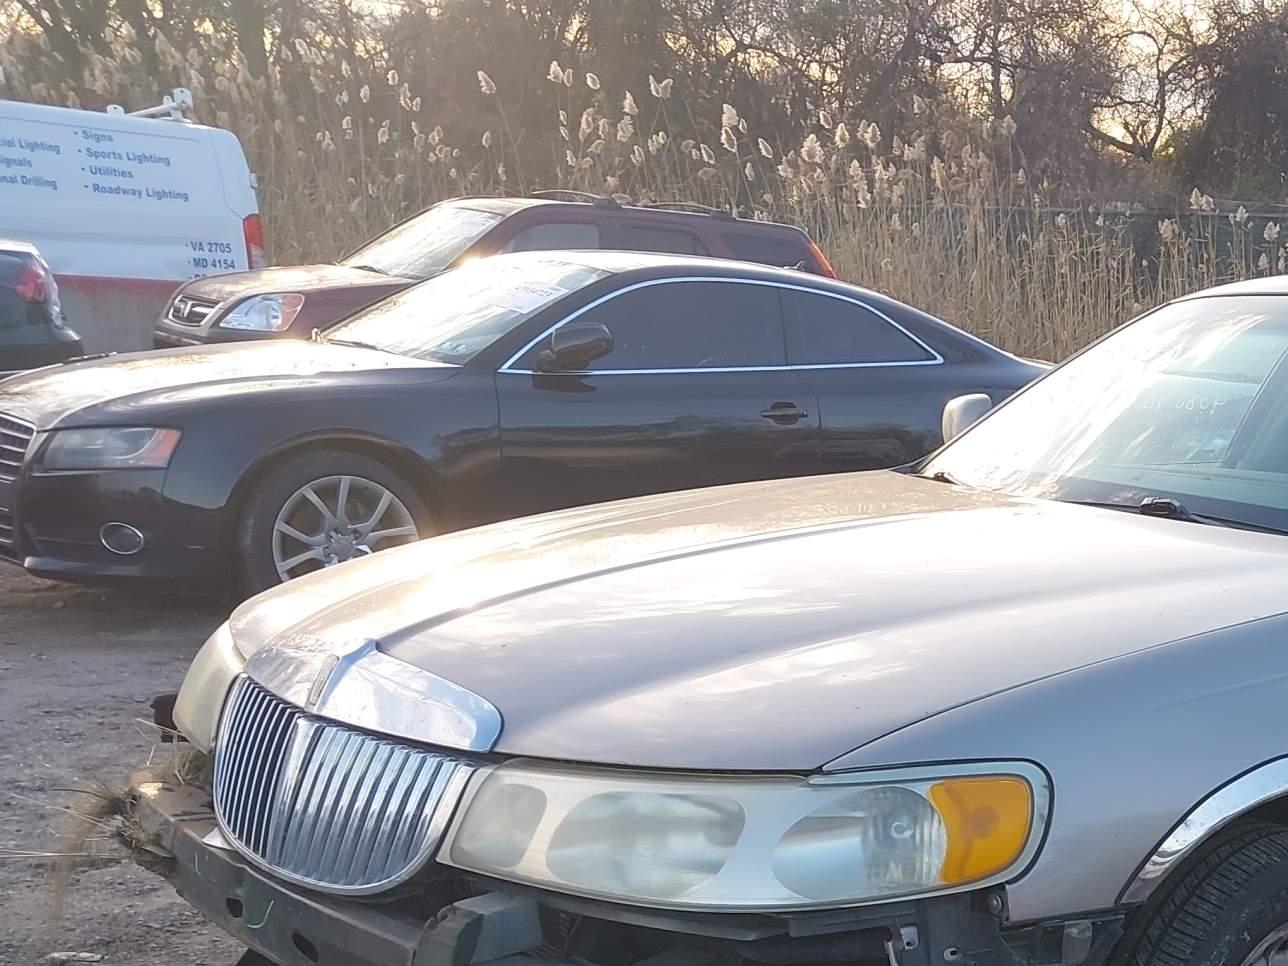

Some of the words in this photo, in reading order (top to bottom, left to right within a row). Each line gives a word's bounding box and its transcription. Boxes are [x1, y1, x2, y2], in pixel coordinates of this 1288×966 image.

[82, 130, 114, 143] Signs
[18, 138, 61, 155] Lighting
[86, 147, 123, 160] Sports
[126, 151, 171, 167] Lighting
[89, 165, 134, 178] Utilities
[21, 175, 58, 190] Drilling
[92, 183, 142, 199] Roadway
[145, 187, 189, 202] Lighting
[190, 241, 205, 252] VA
[207, 242, 232, 254] 2705
[193, 257, 208, 268] MD
[211, 258, 235, 269] 4154
